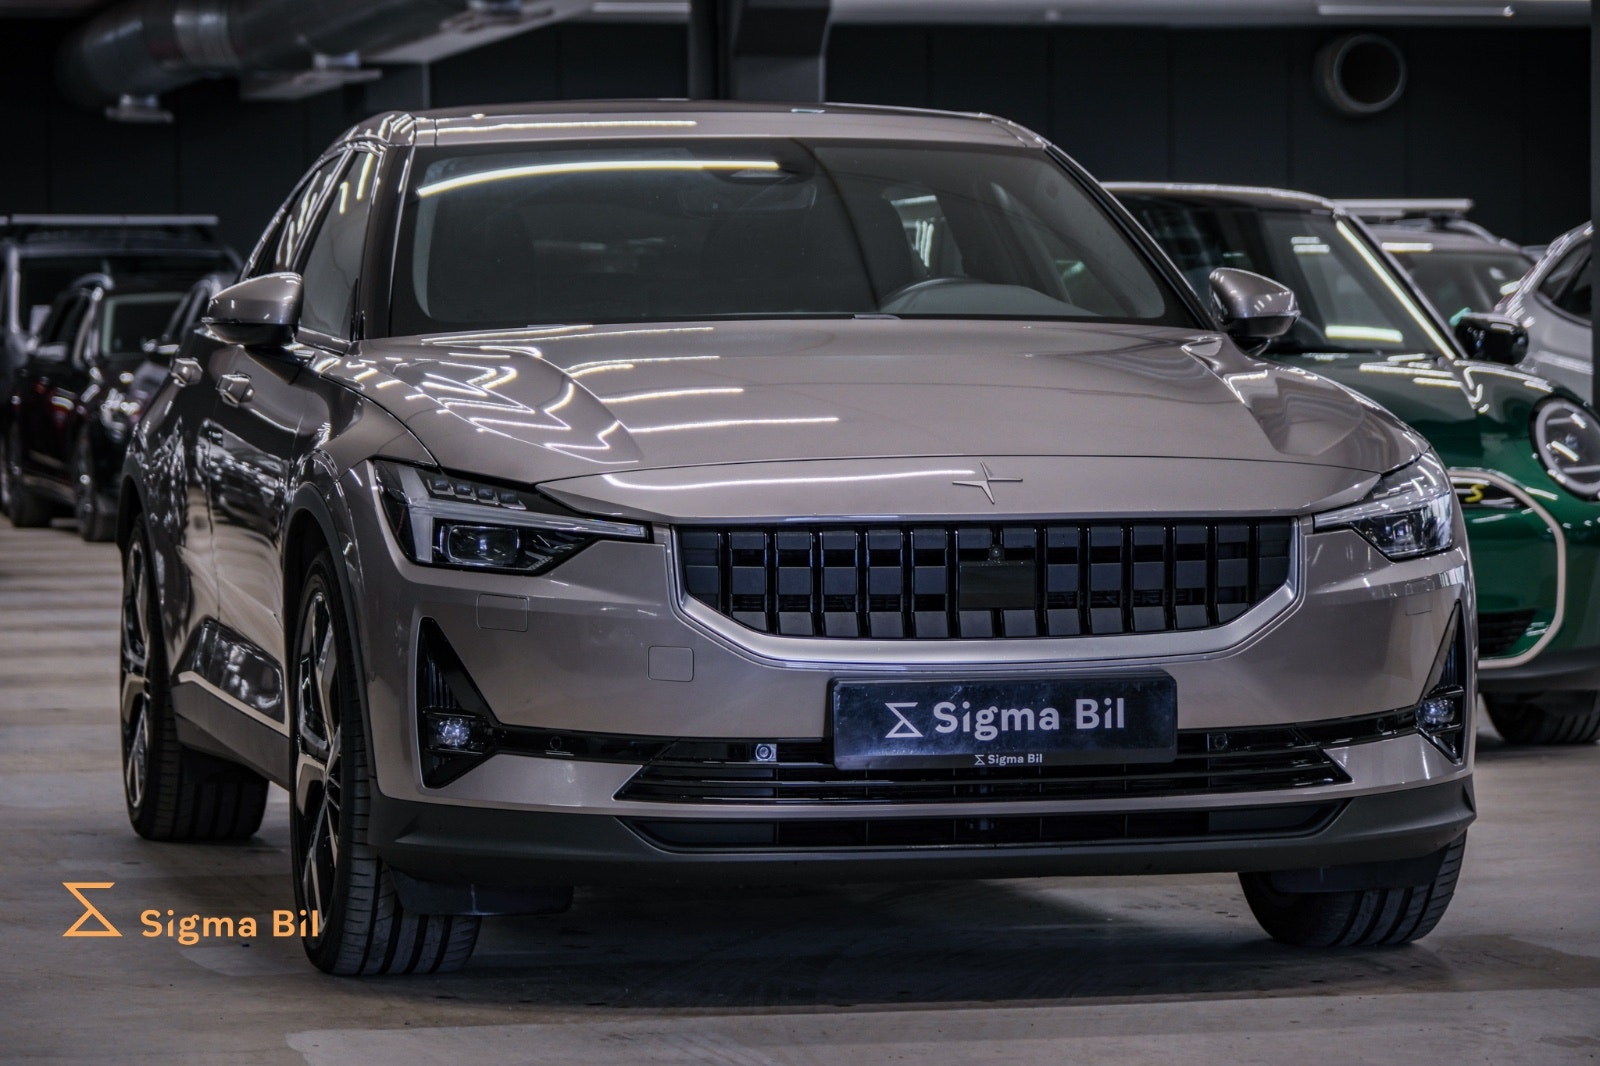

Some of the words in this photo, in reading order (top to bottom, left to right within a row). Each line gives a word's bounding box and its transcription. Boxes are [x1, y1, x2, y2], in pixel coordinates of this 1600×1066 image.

[933, 700, 1060, 741] Sigma
[1075, 697, 1125, 730] Bil
[987, 754, 1024, 766] Sigma
[1027, 753, 1043, 763] Bil
